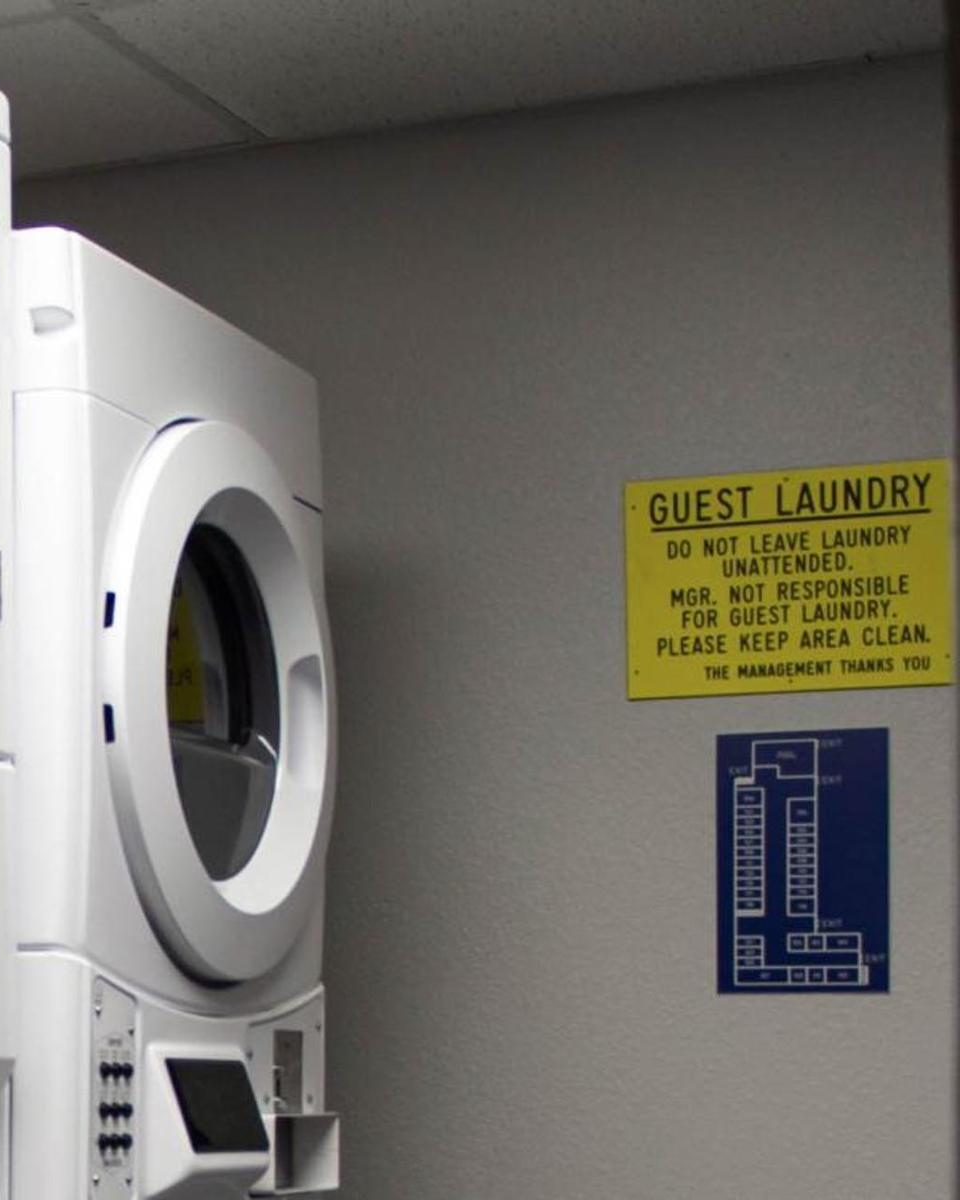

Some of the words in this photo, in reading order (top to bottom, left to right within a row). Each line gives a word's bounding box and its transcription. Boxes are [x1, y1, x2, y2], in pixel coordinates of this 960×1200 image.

[648, 485, 754, 526] GUEST
[776, 472, 932, 517] LAUNDRY
[666, 539, 692, 560] DO
[703, 536, 739, 557] NOT
[750, 530, 810, 555] LEAVE
[821, 525, 911, 550] LAUNDRY
[722, 551, 853, 579] UNATTENDED.
[670, 586, 717, 608] MGR.
[729, 582, 765, 605] NOT
[776, 574, 909, 602] RESPONSIBLE
[681, 608, 718, 630] FOR
[729, 604, 791, 627] GUEST
[801, 598, 898, 624] LAUNDRY.
[656, 634, 728, 657] PLEASE
[739, 630, 789, 653] KEEP
[799, 628, 851, 650] AREA
[861, 623, 931, 647] CLEAN.
[704, 665, 730, 680] THE
[737, 660, 832, 679] MANAGEMENT
[840, 657, 894, 675] THANKS
[902, 655, 931, 671] YOU
